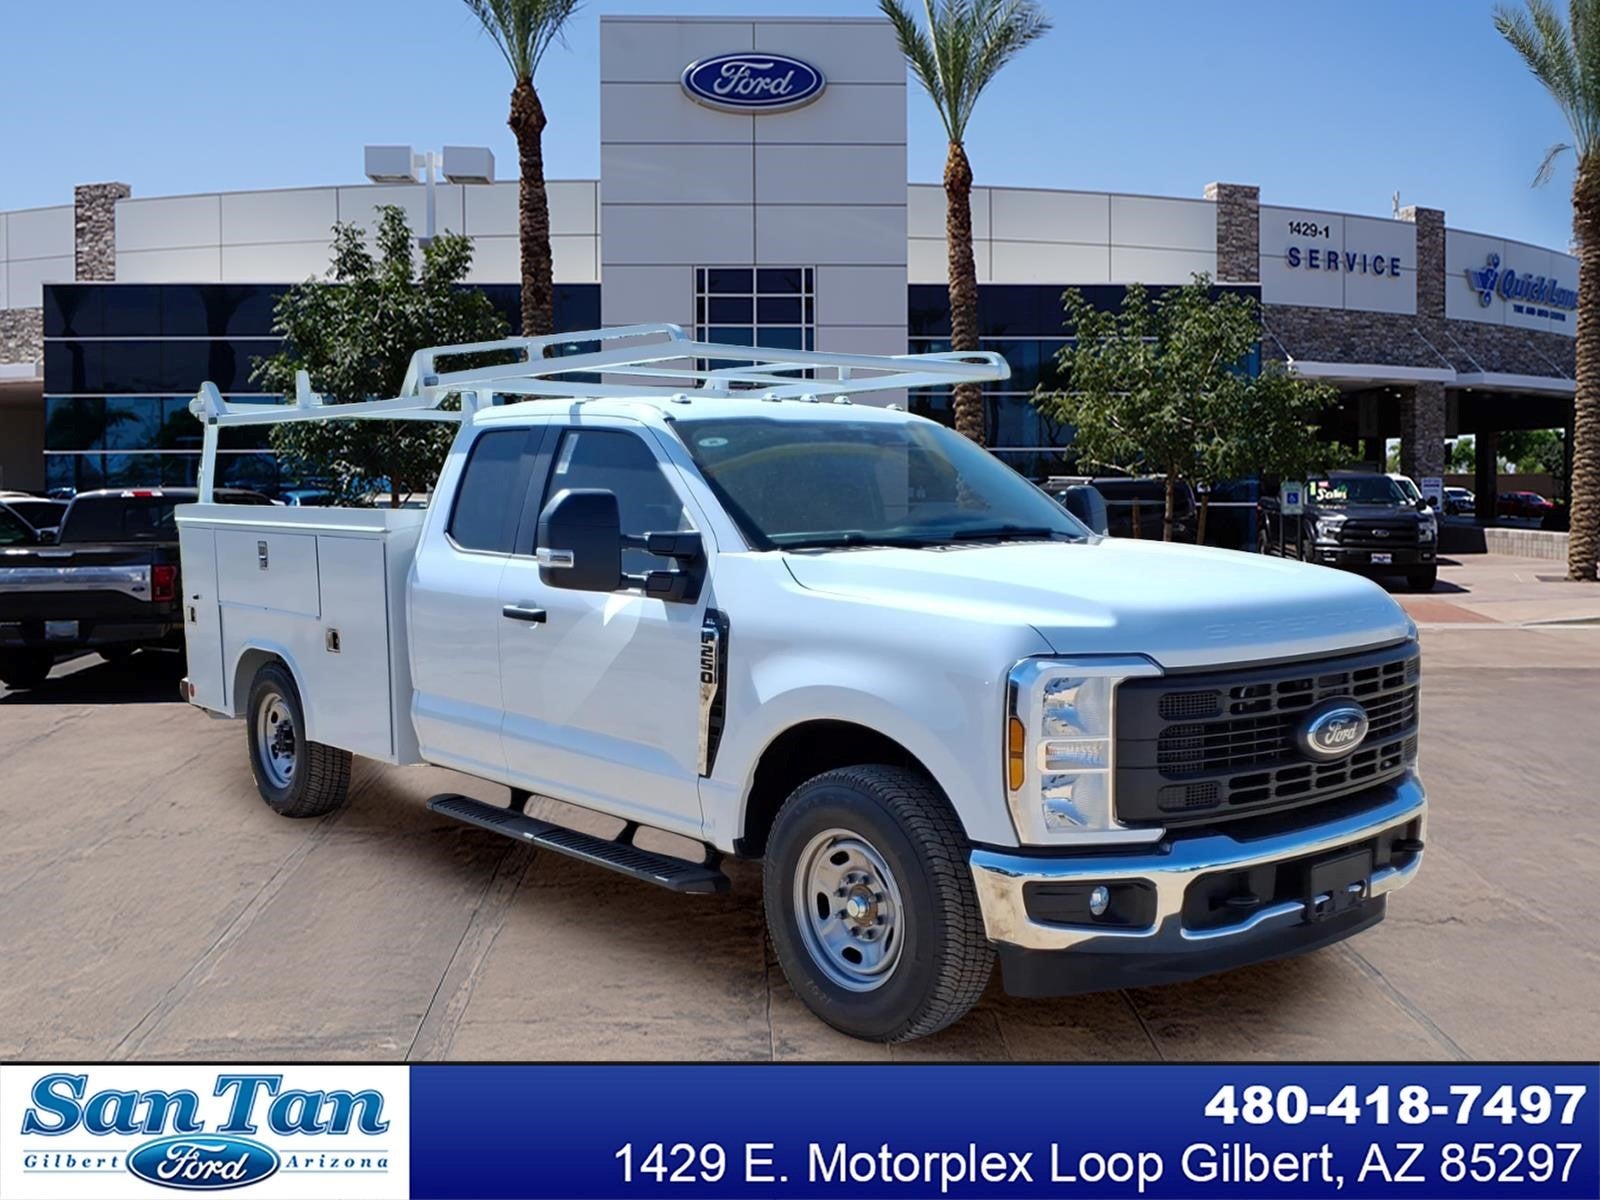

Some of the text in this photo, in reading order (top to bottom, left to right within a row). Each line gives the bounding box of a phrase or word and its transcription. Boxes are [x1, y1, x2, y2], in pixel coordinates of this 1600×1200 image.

[713, 61, 795, 95] Ford
[1288, 246, 1401, 277] SERVICE
[1324, 718, 1358, 745] Ford
